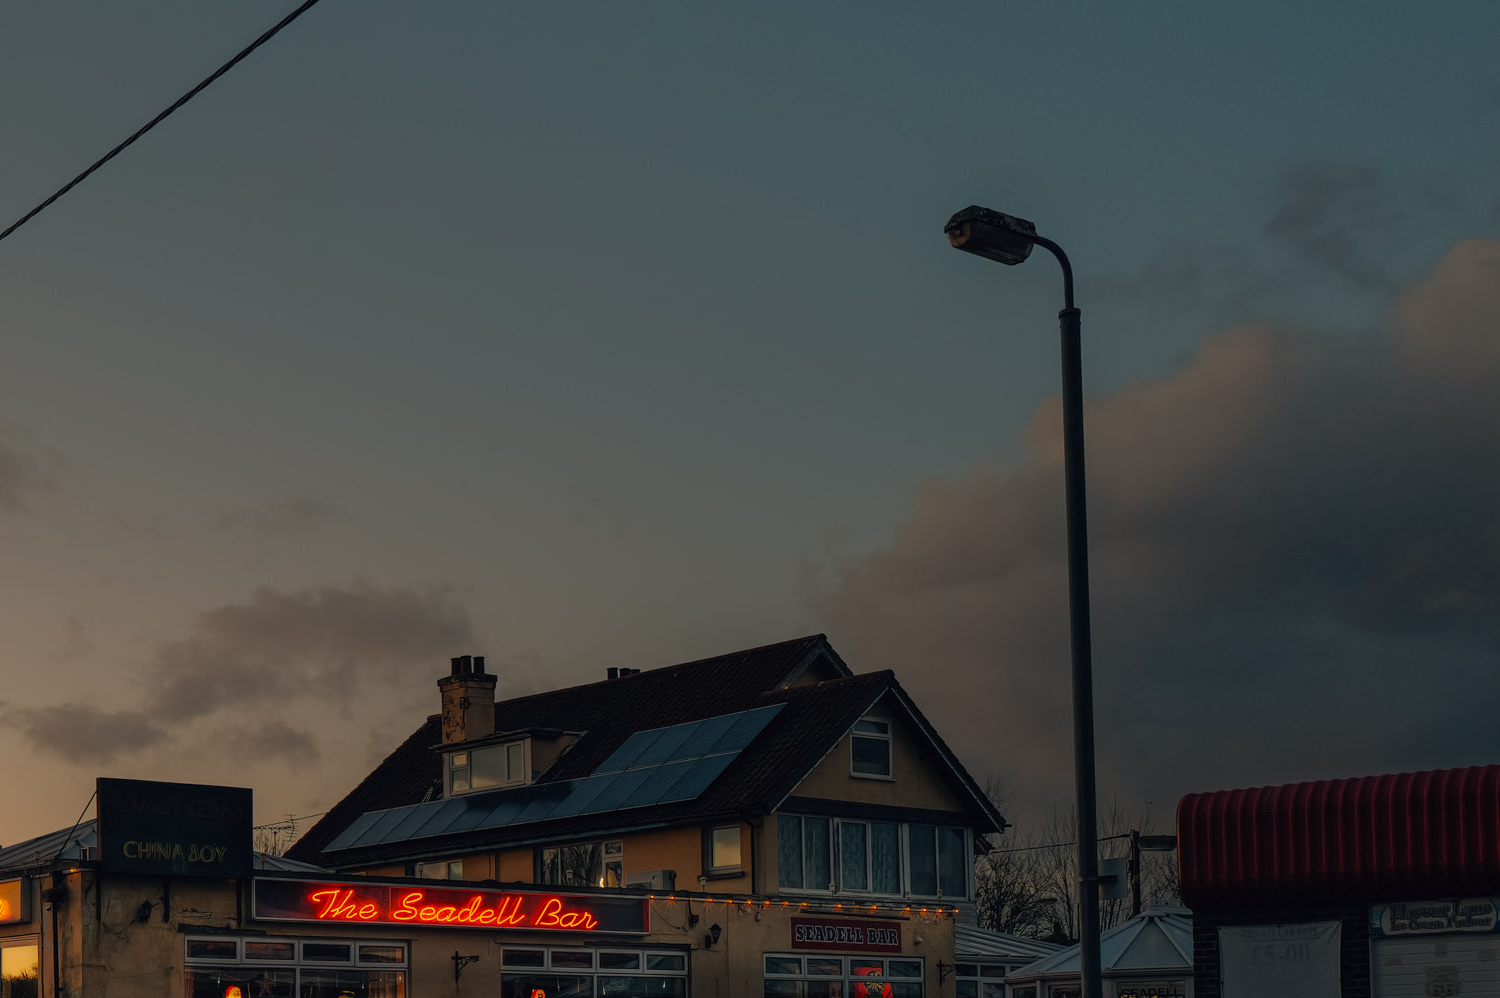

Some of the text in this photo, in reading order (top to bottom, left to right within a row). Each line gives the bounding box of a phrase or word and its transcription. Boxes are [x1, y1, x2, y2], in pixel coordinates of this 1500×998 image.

[123, 840, 228, 863] CHINA BOY
[311, 889, 599, 930] The Seadell Bar
[795, 925, 899, 946] SEADELL BAR
[1121, 987, 1179, 998] SEADELL
